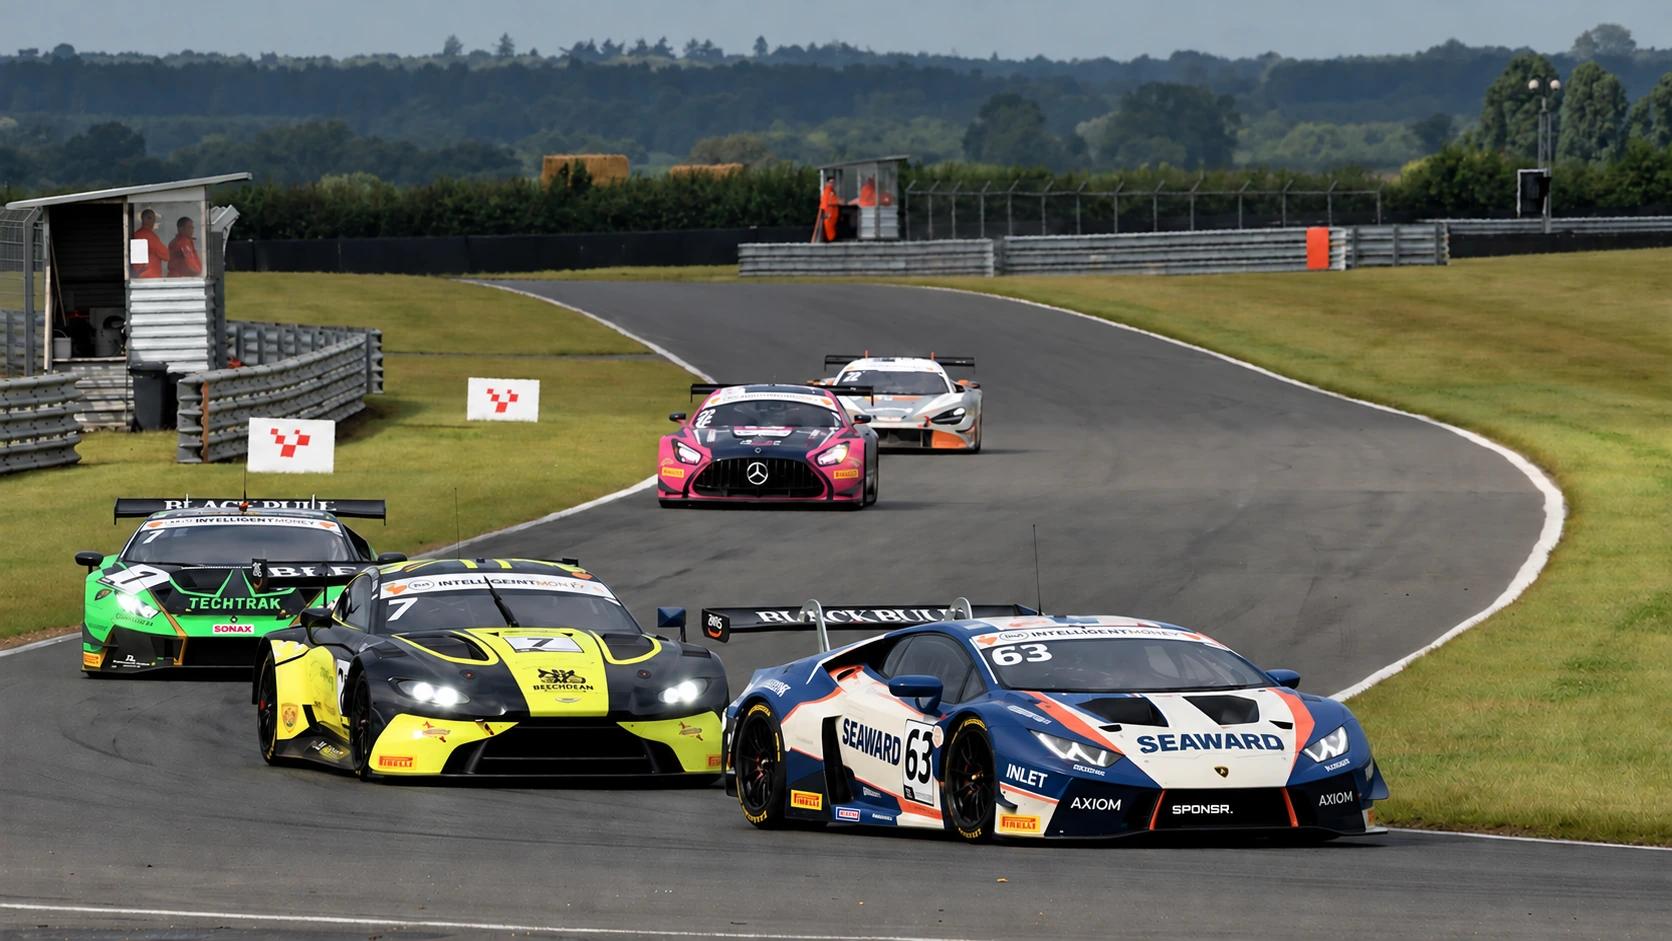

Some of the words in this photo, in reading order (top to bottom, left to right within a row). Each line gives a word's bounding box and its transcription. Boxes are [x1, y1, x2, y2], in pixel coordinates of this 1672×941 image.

[189, 598, 281, 610] TECHTRAK
[387, 598, 418, 622] 7
[214, 625, 252, 633] SONAX
[527, 637, 554, 648] 7
[991, 643, 1052, 666] 63
[842, 718, 902, 767] SEAWARD
[1137, 733, 1285, 754] SEAWARD
[905, 728, 933, 784] 63
[1006, 763, 1048, 788] INLET
[1070, 796, 1122, 811] AXIOM
[1319, 790, 1354, 807] AXIOM
[1172, 804, 1233, 815] SPONSR.
